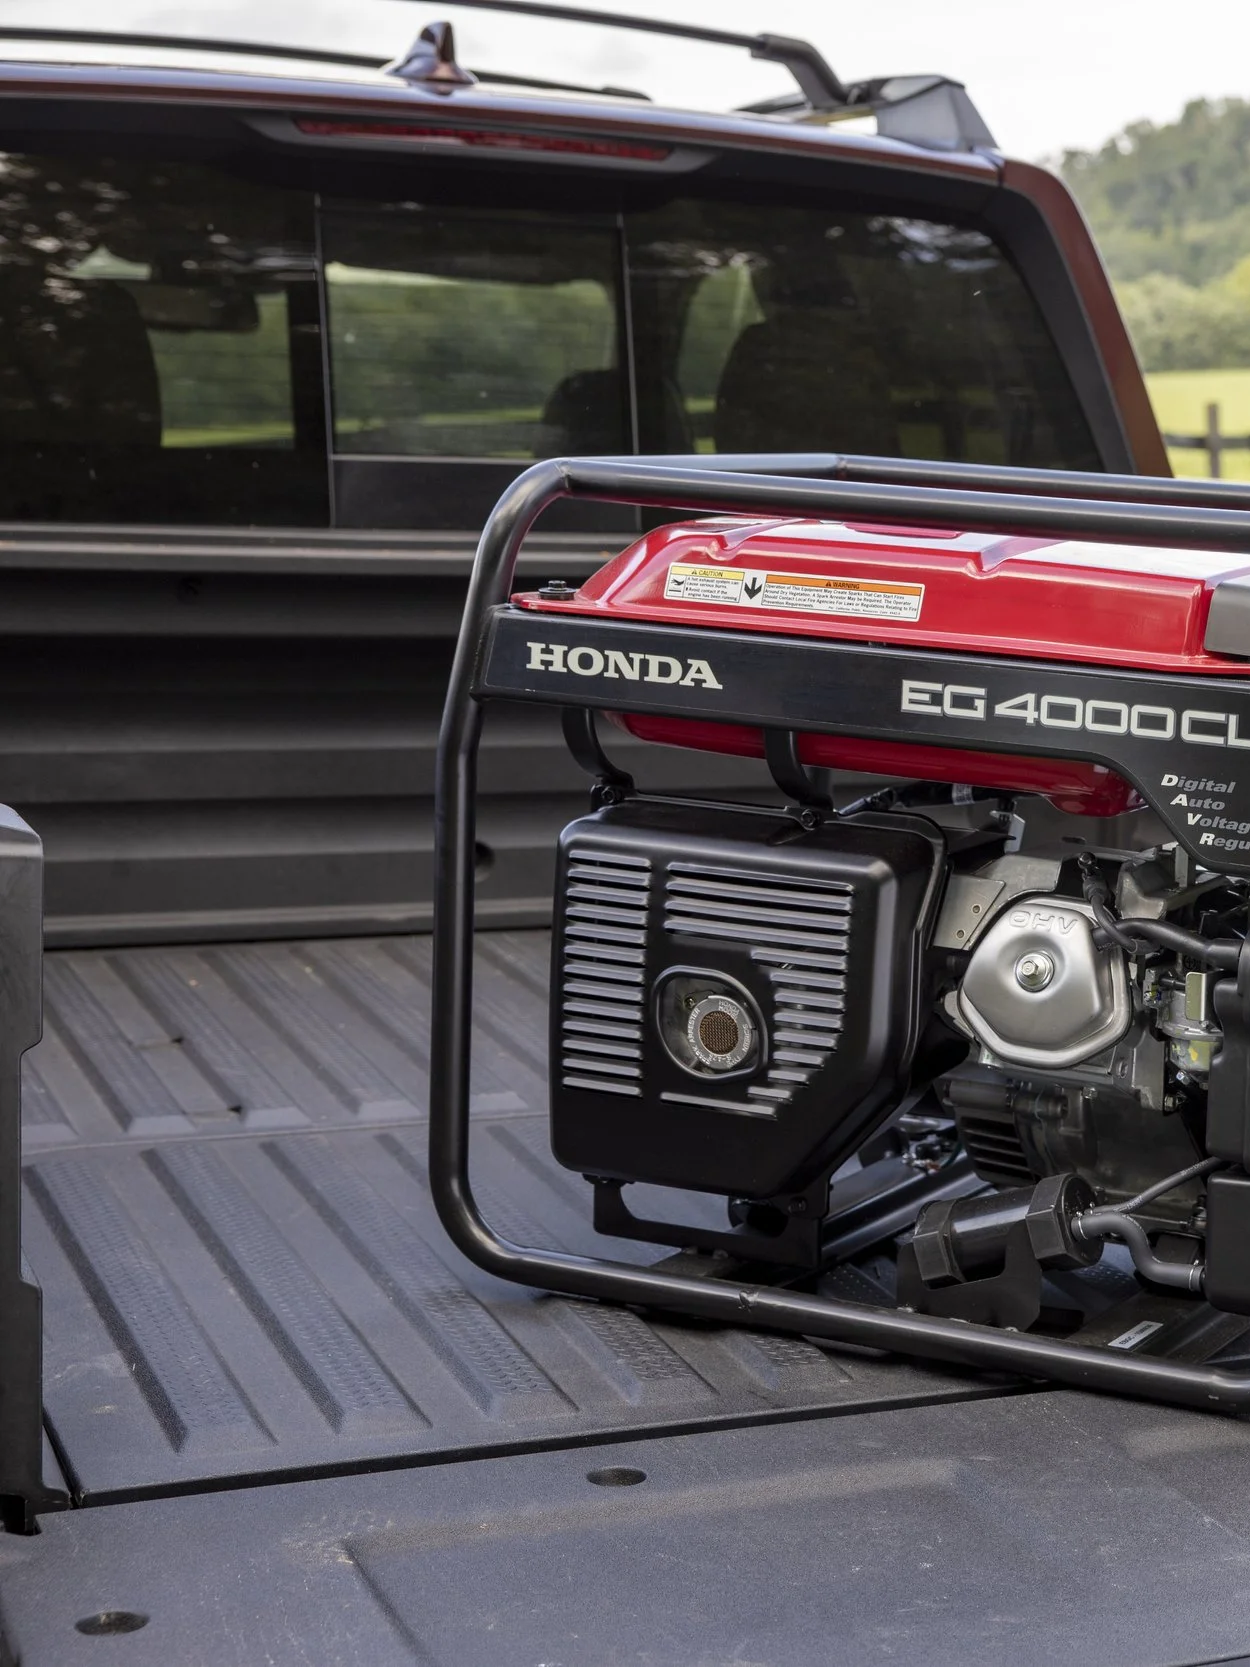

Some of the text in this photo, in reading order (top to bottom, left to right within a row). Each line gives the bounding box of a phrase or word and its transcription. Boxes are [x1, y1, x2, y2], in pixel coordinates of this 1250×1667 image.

[526, 642, 723, 690] HONDA
[1160, 774, 1236, 794] Digital
[1170, 793, 1225, 810] Auto
[1009, 910, 1078, 935] OHV
[719, 1000, 739, 1015] HONDA
[688, 1007, 700, 1042] ARRESTER
